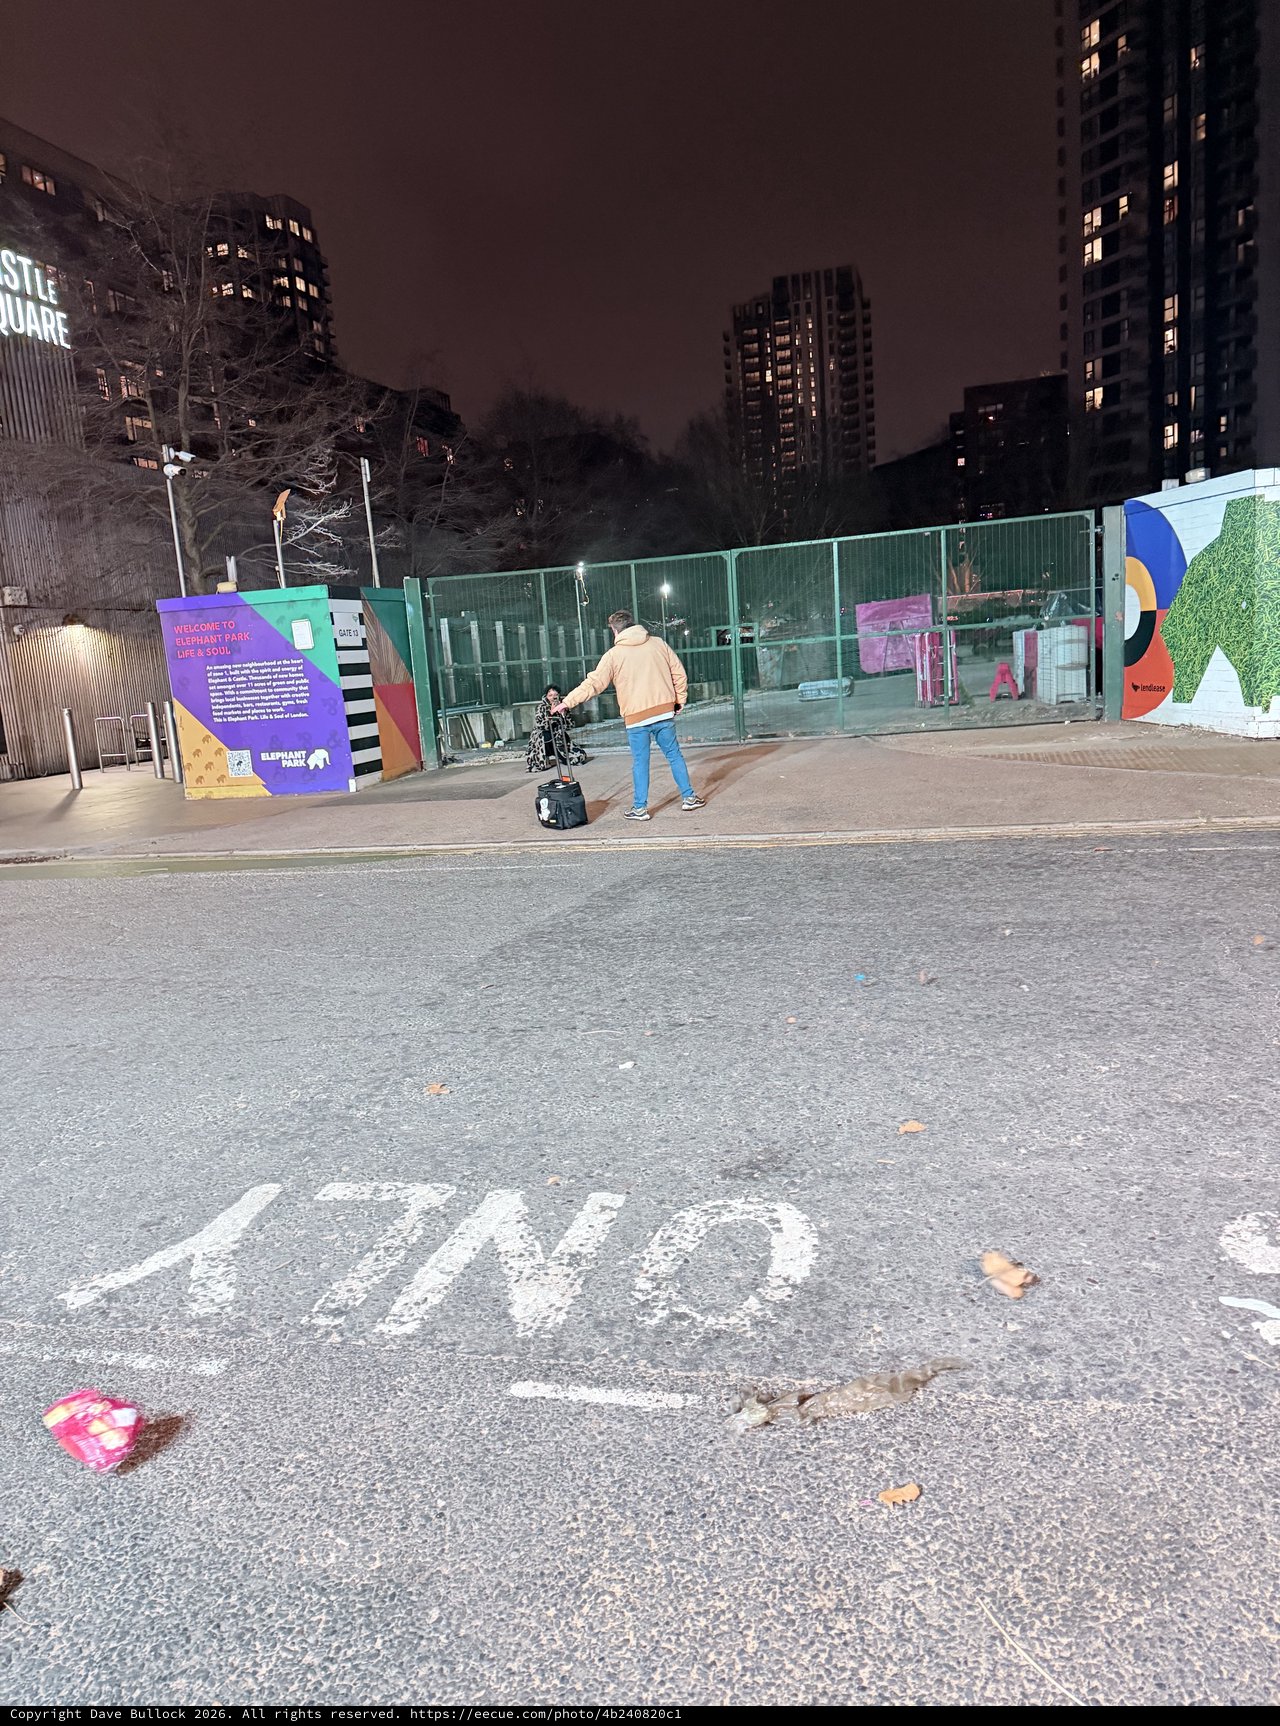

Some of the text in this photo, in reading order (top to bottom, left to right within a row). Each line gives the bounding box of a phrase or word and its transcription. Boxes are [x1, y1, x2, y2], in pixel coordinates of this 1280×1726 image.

[0, 249, 58, 305] STLE
[174, 620, 235, 634] WELCOME TO
[339, 629, 352, 637] GATE
[175, 632, 252, 646] ELEPHANT PARK.
[177, 646, 231, 658] LIFE & SOUL
[243, 660, 276, 668] neighbourhood
[1141, 684, 1165, 692] lendlease
[261, 751, 306, 760] ELEPHANT
[282, 759, 306, 767] PARK
[56, 1183, 818, 1340] ONLY
